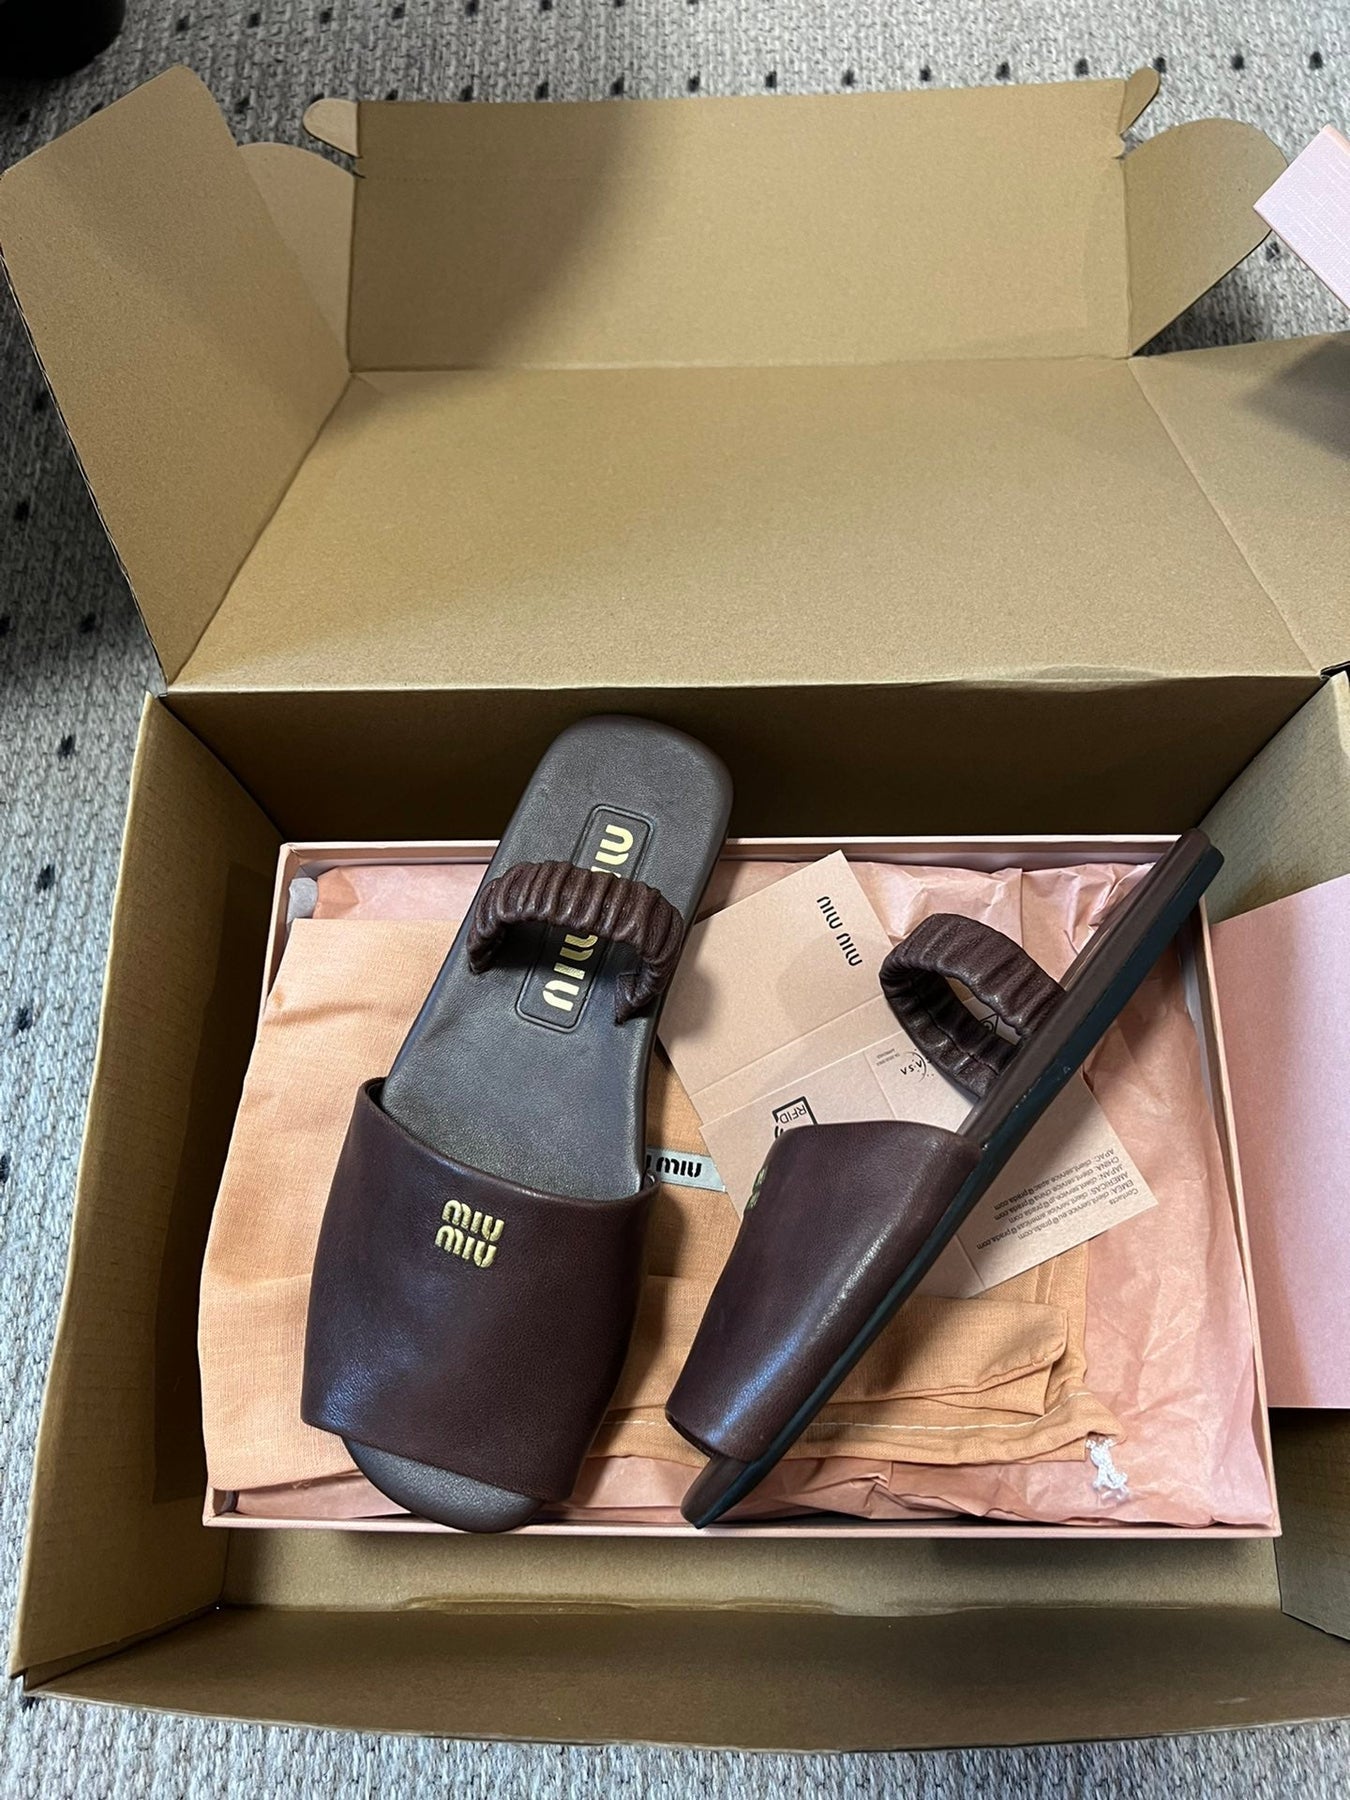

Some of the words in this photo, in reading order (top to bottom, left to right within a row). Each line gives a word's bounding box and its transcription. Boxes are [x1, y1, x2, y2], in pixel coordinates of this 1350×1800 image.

[779, 1104, 807, 1124] RFID
[1092, 1155, 1119, 1172] CHINA:
[1096, 1163, 1124, 1179] JAPAN:
[1087, 1171, 1129, 1195] AMERICAS:
[1109, 1179, 1133, 1194] EMEA:
[1108, 1186, 1139, 1204] Contacts
